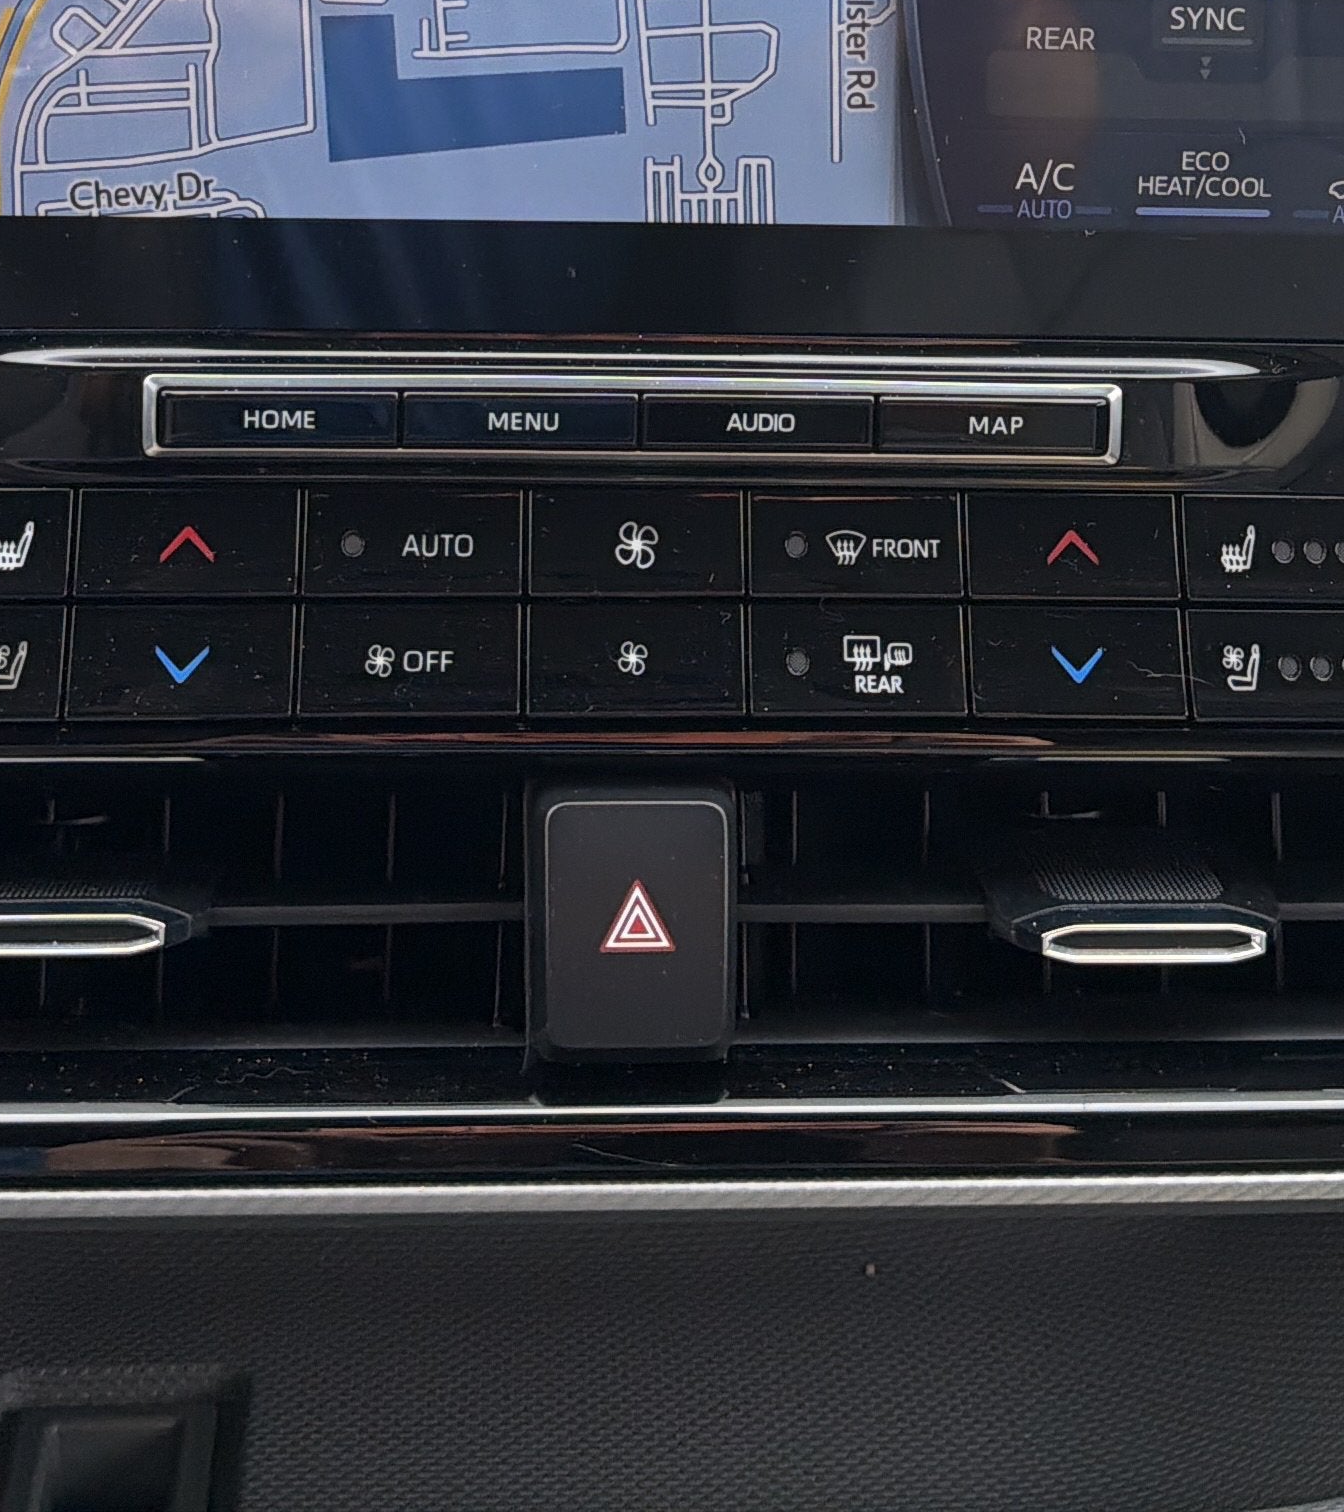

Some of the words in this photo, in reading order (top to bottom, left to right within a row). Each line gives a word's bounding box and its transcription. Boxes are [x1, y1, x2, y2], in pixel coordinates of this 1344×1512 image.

[1169, 6, 1245, 32] SYNC
[1026, 27, 1095, 51] REAR
[846, 68, 876, 111] Rd
[1181, 151, 1229, 171] ECO
[1015, 159, 1075, 194] A/C
[1137, 174, 1271, 199] HEAT/COOL
[69, 179, 167, 211] Chevy
[177, 172, 214, 202] Dr
[1016, 199, 1072, 220] AUTO
[243, 409, 316, 430] HOME
[488, 412, 559, 431] MENU
[726, 412, 796, 434] AUDIO
[968, 414, 1024, 435] MAP
[402, 535, 474, 558] AUTO
[871, 538, 941, 560] FRONT
[403, 650, 454, 672] OFF
[854, 674, 904, 695] REAR
